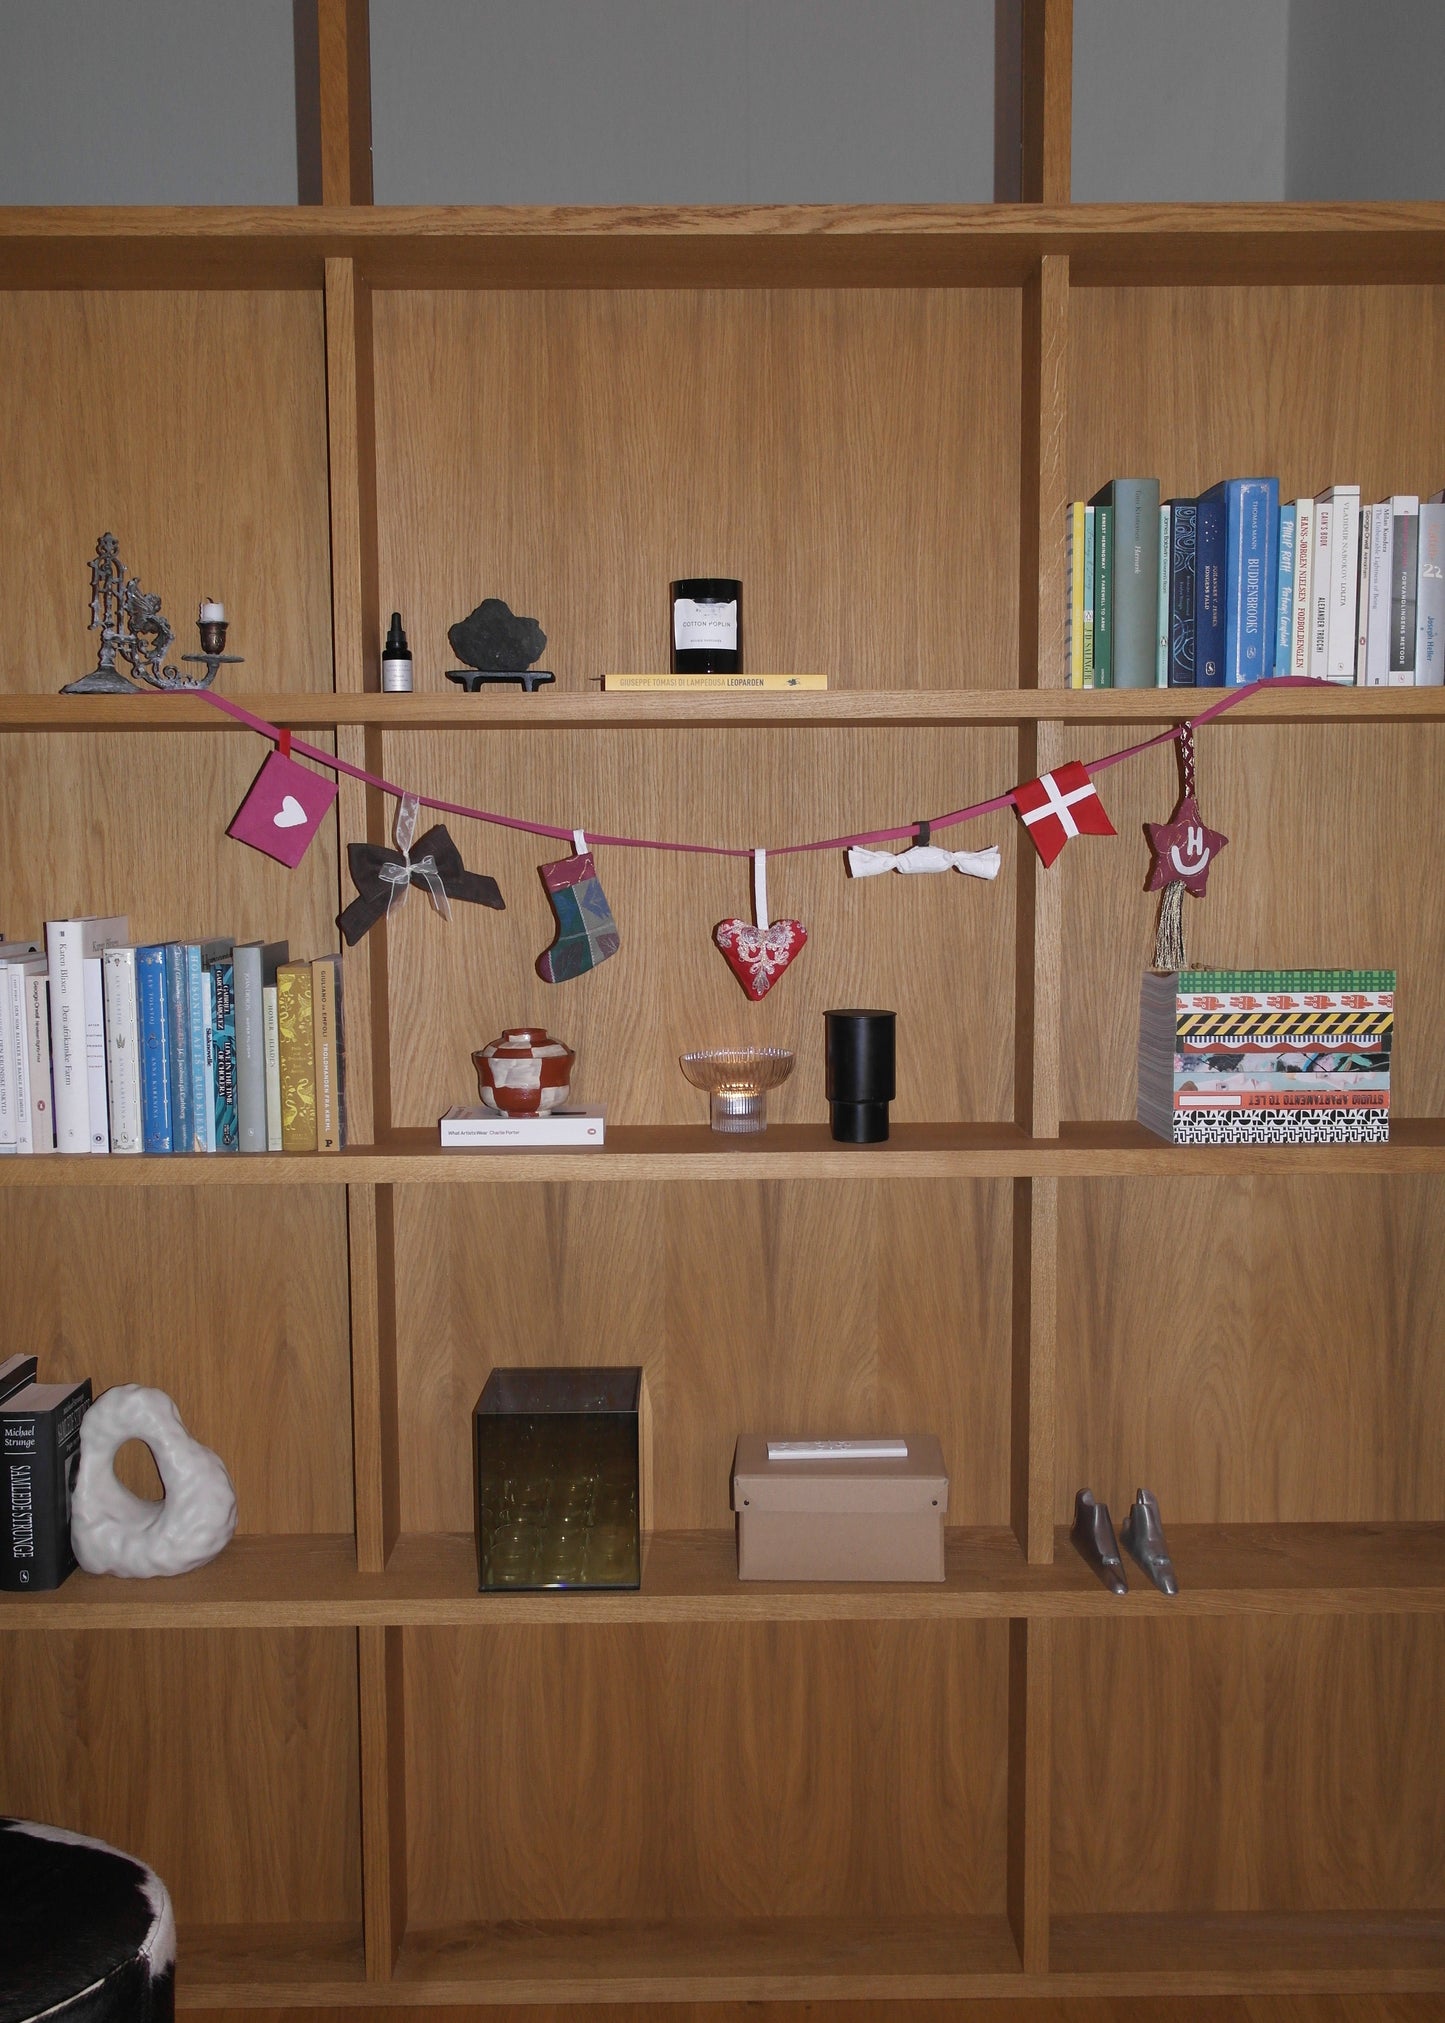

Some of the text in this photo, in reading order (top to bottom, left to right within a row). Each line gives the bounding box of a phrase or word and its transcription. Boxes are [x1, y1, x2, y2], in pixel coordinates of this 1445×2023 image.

[1282, 521, 1294, 549] PHILIP
[1342, 502, 1350, 541] VLADIMIR
[1374, 521, 1382, 554] Unbearable
[1280, 550, 1292, 572] ROTH
[1341, 543, 1349, 580] NABOKOV
[1423, 564, 1443, 578] 22
[1245, 558, 1260, 634] BUDDENBROOKS
[1296, 516, 1308, 668] HANS-JØRGEN NIELSEN FODBOLDENGLEN
[1316, 512, 1329, 653] CAIN'S BOOK ALEXANDER TROCCHI
[1426, 616, 1435, 662] Joseph Heller
[1084, 643, 1092, 680] SALINGER
[620, 679, 764, 687] GIUSEPPE TOMASI DI LAMPEDUSA LEOPARDEN
[191, 955, 201, 1031] HORISONTER
[59, 943, 73, 1086] Karen Blixen Den afrikanske Farm
[193, 1037, 202, 1047] AF
[194, 1054, 202, 1065] IS
[218, 1051, 226, 1096] OF CHOLERA
[225, 1062, 232, 1070] IN
[195, 1076, 204, 1100] RUD
[1248, 1095, 1384, 1105] STUDIO APARTAMENTO TO LET
[4, 1426, 35, 1437] Michael
[4, 1438, 35, 1448] Strunge
[10, 1465, 34, 1558] SAMLEDE STRUNGE
